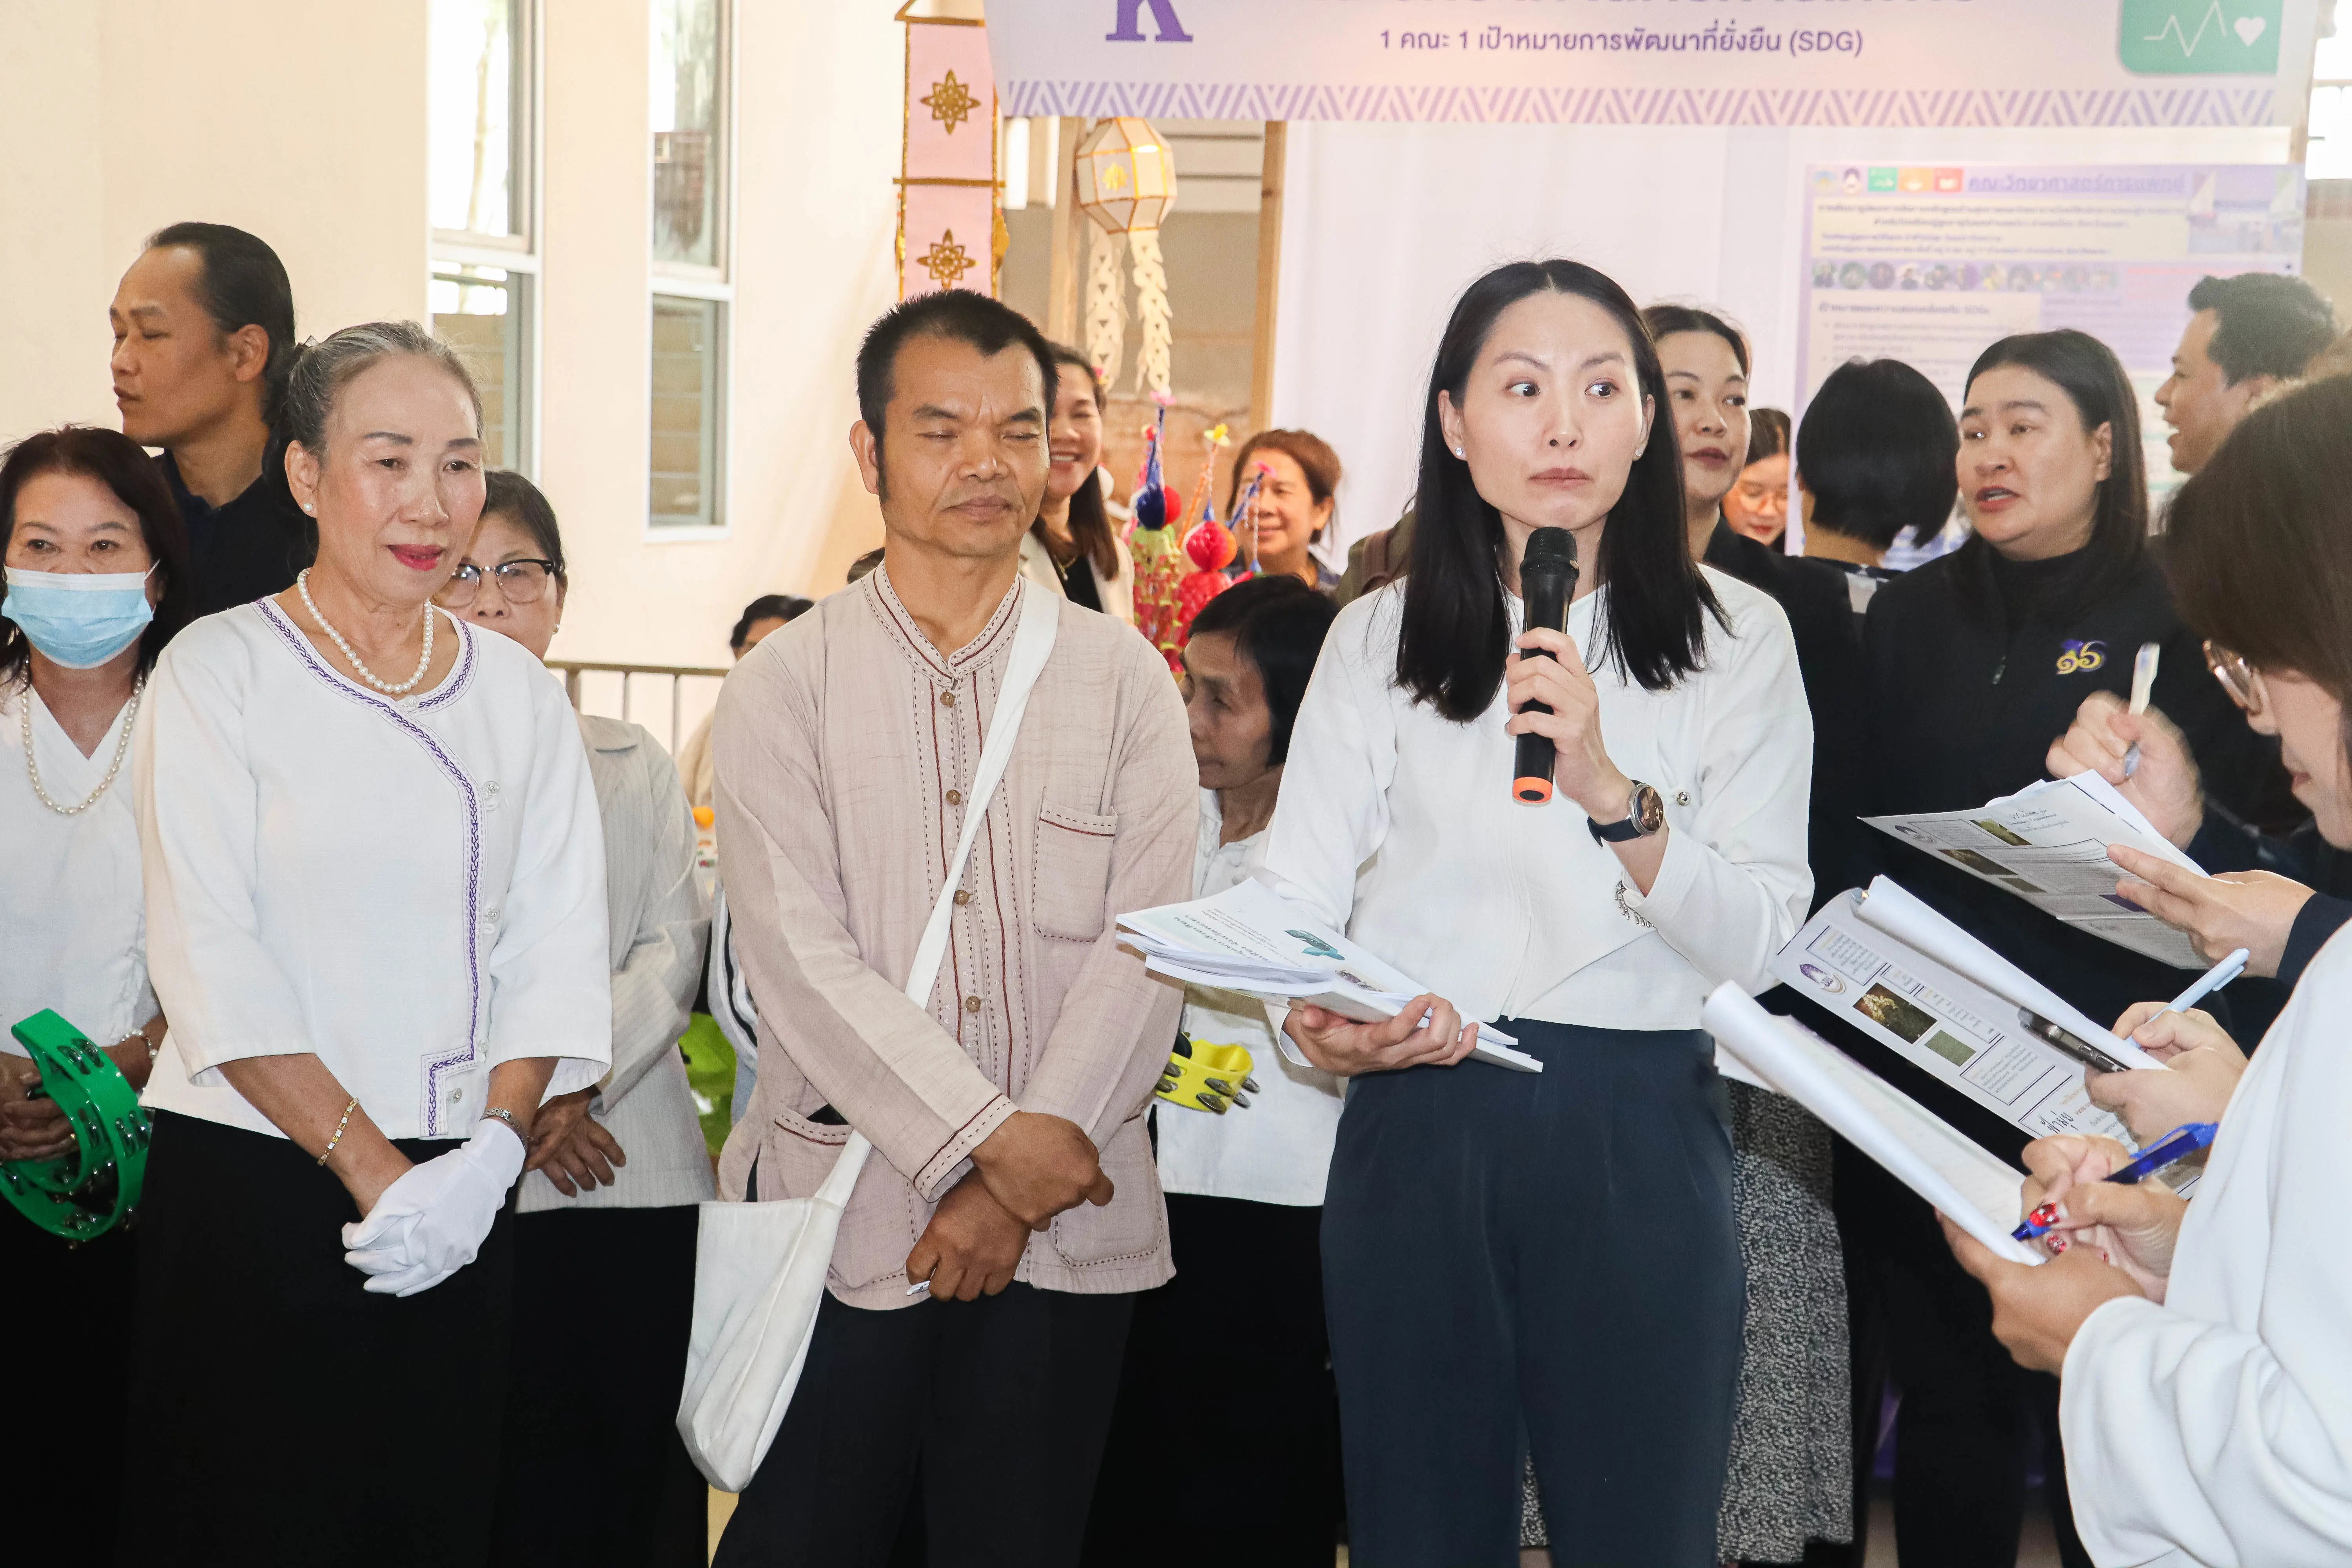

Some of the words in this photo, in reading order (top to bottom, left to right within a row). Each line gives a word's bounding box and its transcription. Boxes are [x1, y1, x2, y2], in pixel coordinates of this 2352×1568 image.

[1380, 31, 1388, 49] 1
[1400, 31, 1450, 49] คณะ
[1459, 31, 1467, 49] 1
[1480, 19, 1782, 51] เป้าหมายการพัฒนาที่ยั่งยืน
[1790, 30, 1862, 57] (SDG)
